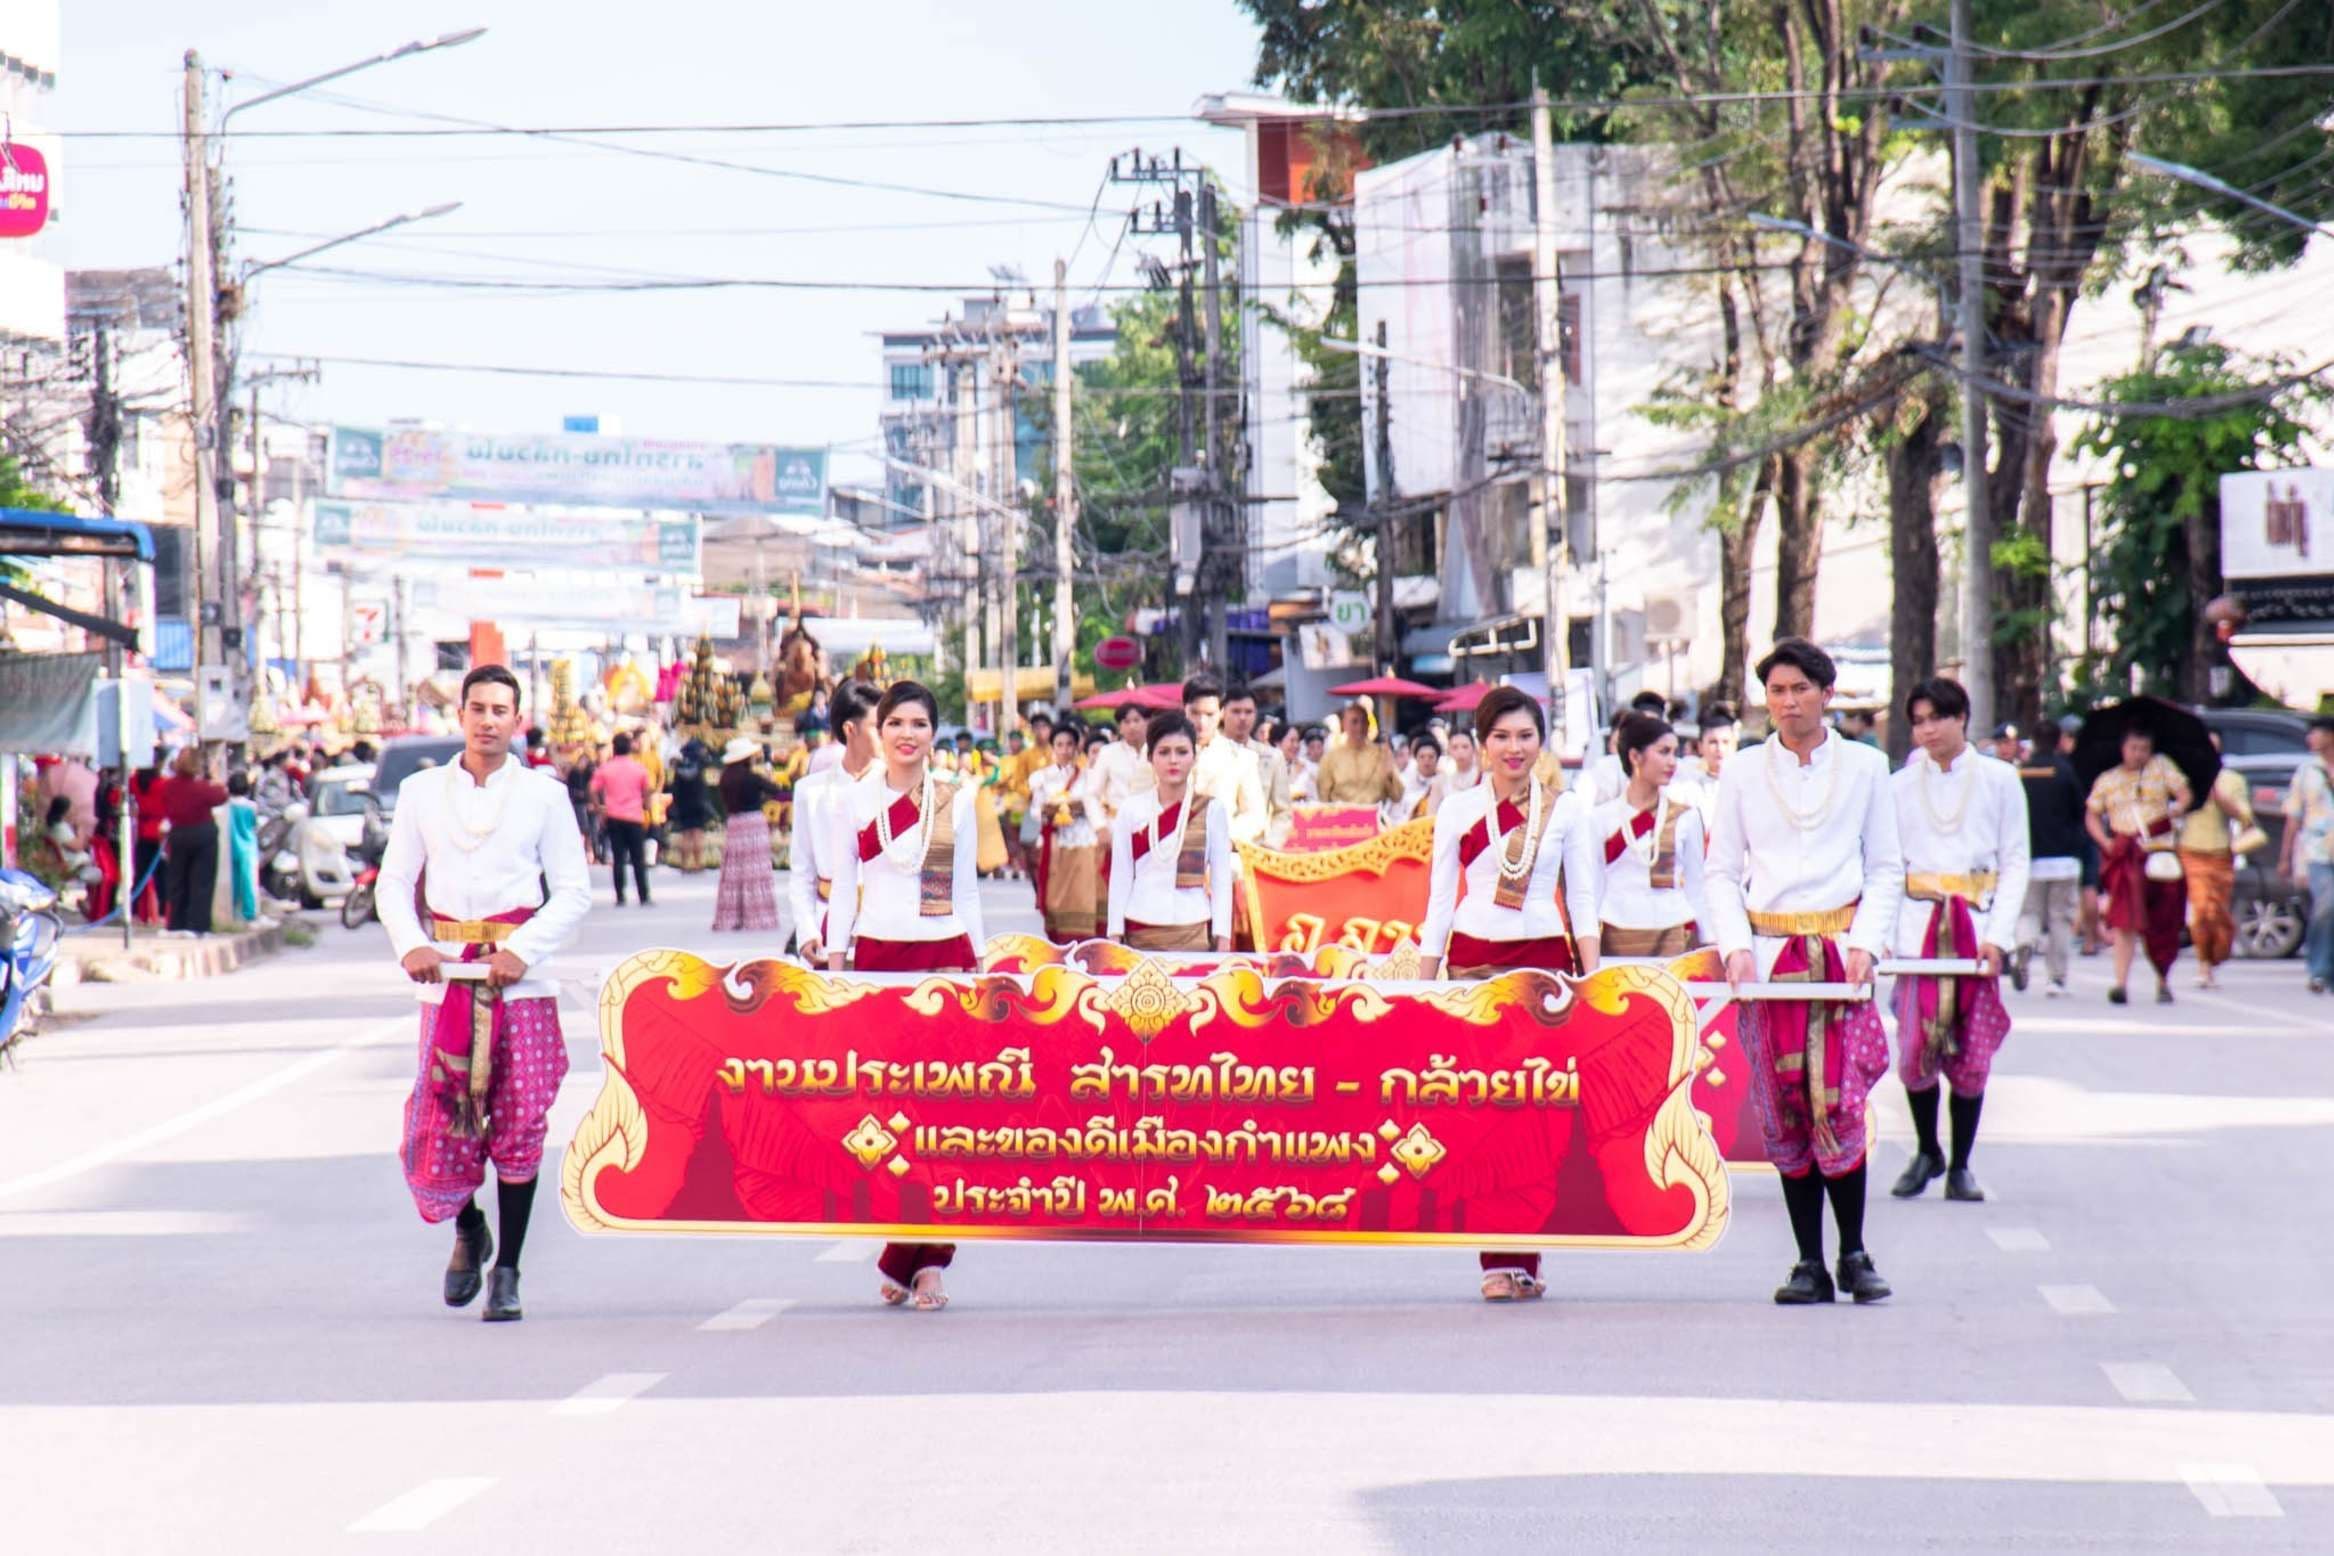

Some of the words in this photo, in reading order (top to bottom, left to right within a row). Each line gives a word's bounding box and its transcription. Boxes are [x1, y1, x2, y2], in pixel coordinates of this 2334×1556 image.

[717, 1046, 1037, 1098] งานประเพณี
[1070, 1046, 1316, 1101] สารทไทย
[1380, 1053, 1581, 1106] กล้วยไข่
[914, 1115, 1376, 1163] และของดีเมืองกำแพง
[933, 1175, 1086, 1216] ประจำปี
[1098, 1175, 1187, 1219] พ.ศ.
[1205, 1183, 1357, 1220] ๒๕๖๘
